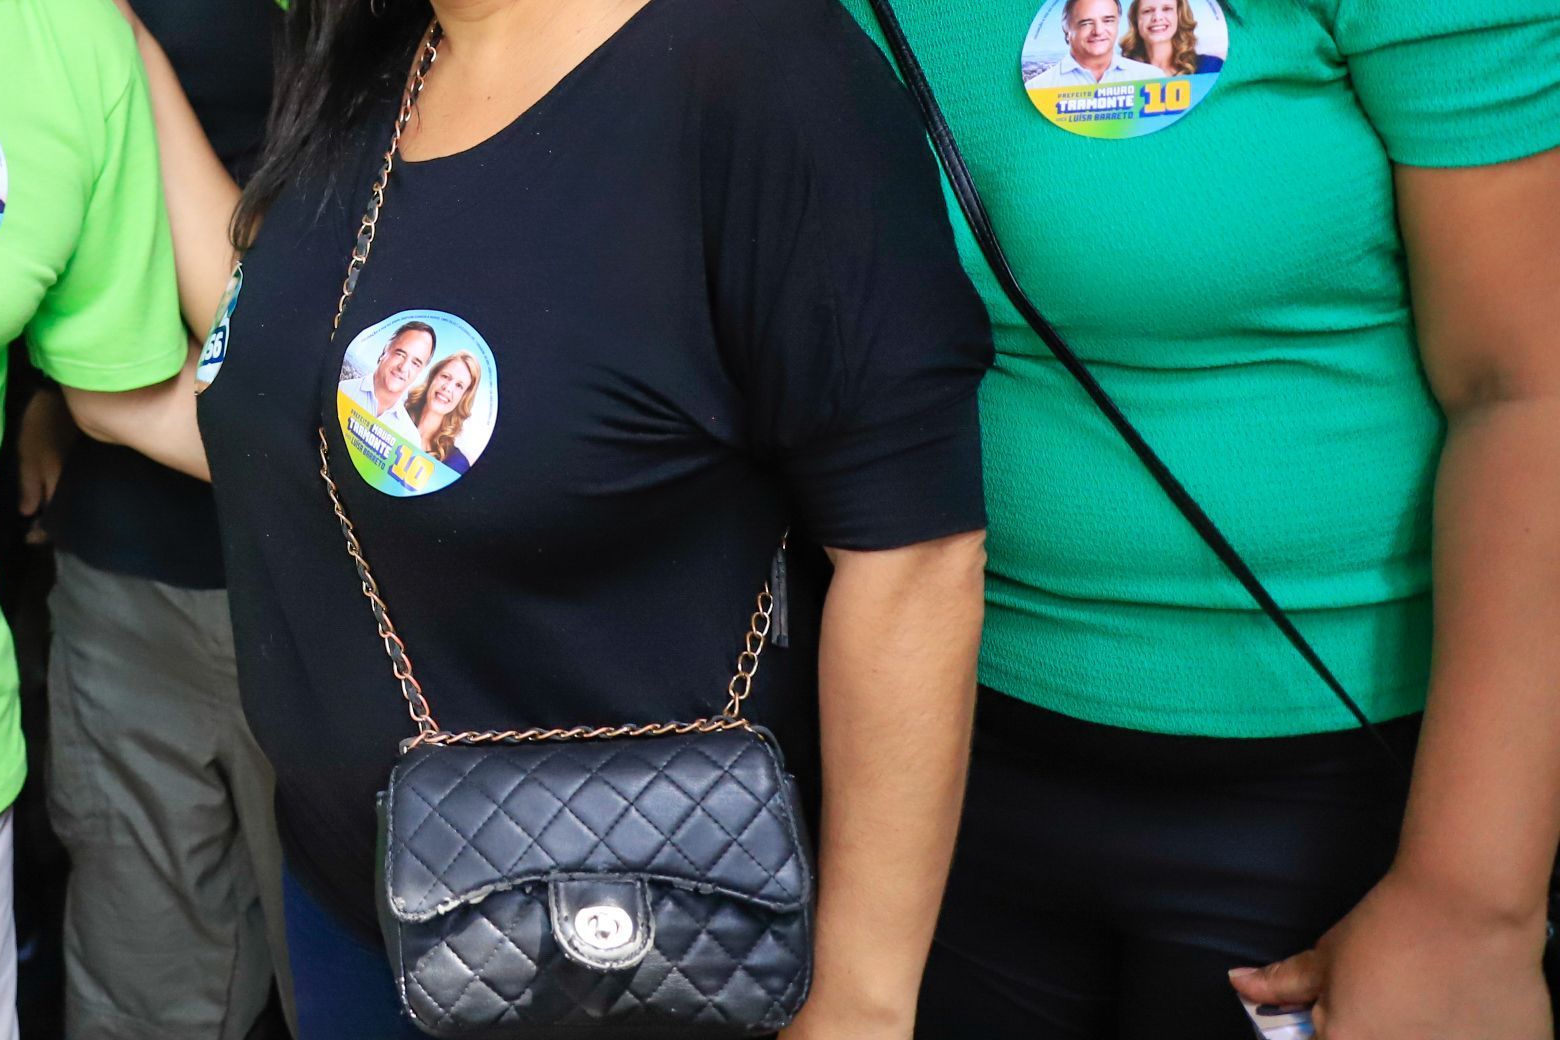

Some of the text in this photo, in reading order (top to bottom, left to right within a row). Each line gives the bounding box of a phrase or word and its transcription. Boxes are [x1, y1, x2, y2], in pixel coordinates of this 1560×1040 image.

[1095, 85, 1135, 98] MAURO
[1140, 80, 1191, 117] 10
[1056, 95, 1134, 114] TRAMONTE
[1094, 111, 1134, 121] BARRETO
[348, 417, 392, 459] TRAMONTE
[371, 424, 396, 447] MAURO
[388, 445, 435, 491] 10
